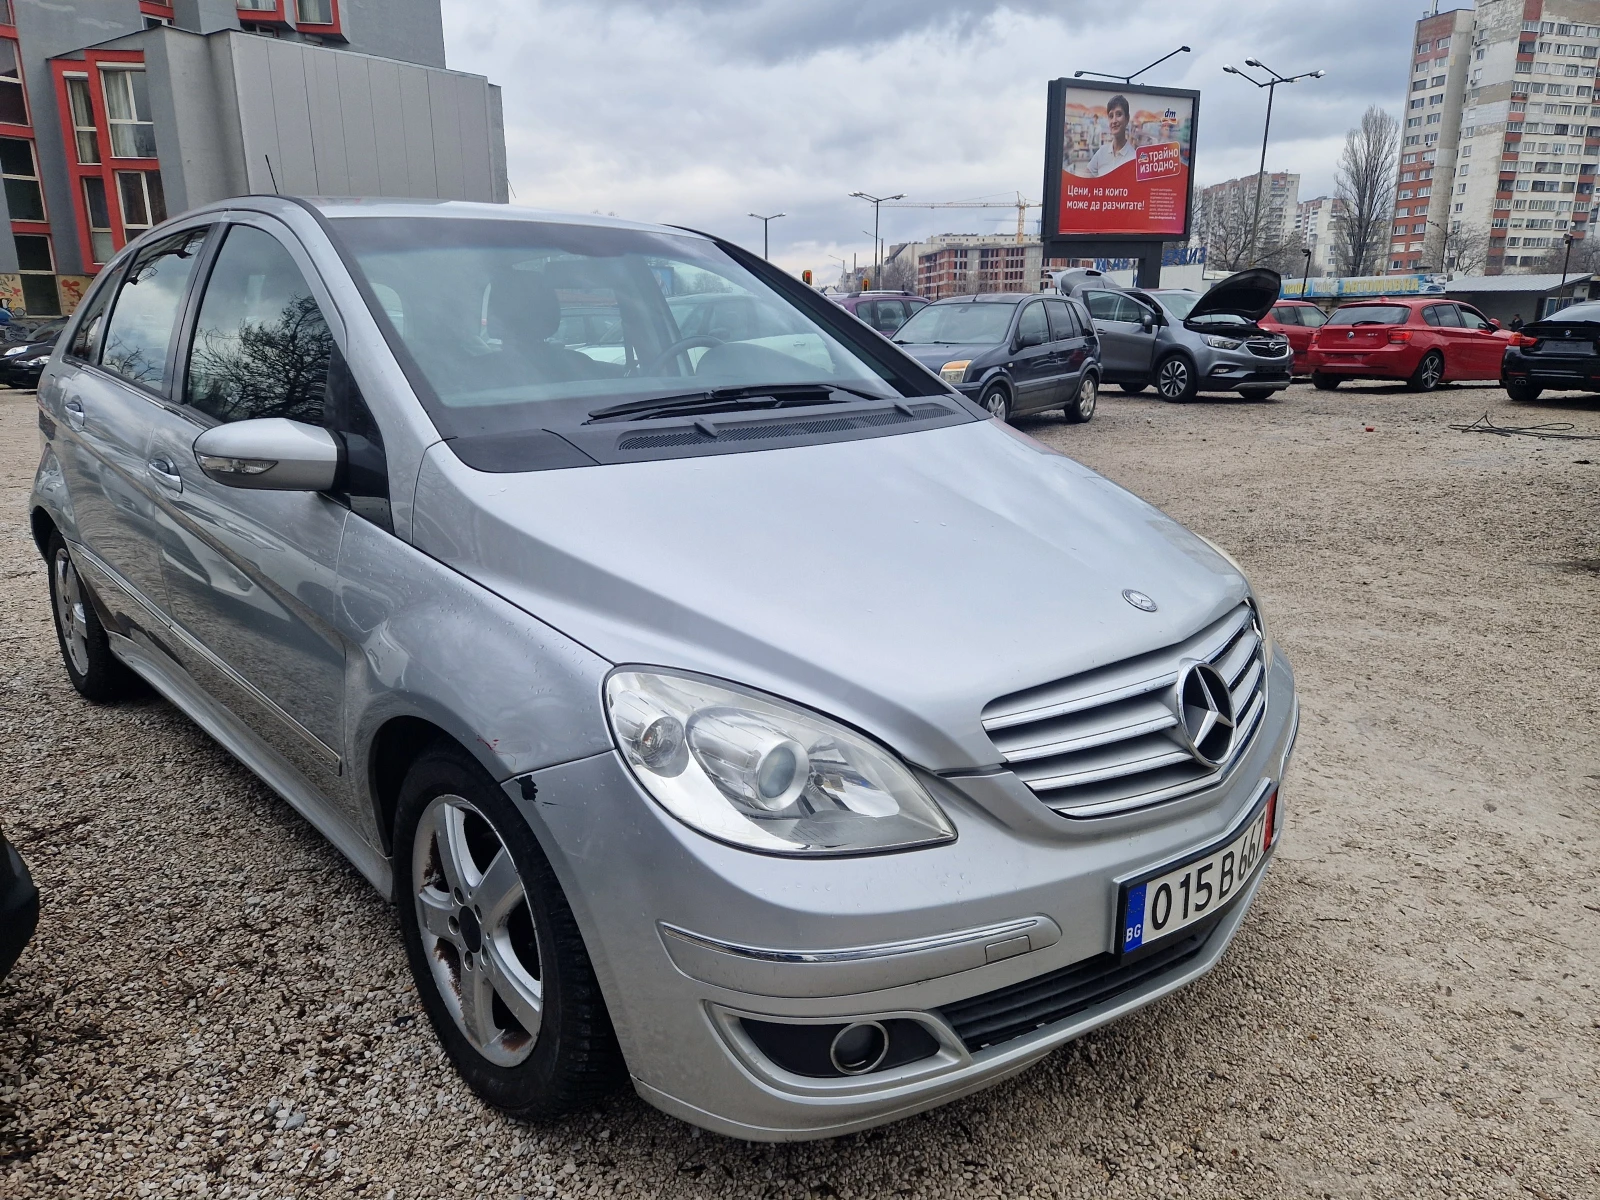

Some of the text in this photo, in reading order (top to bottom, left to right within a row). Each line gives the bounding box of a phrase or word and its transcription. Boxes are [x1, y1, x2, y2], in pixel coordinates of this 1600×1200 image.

[1165, 108, 1176, 118] dm
[1149, 147, 1178, 162] трайно
[1067, 185, 1128, 197] Цени, на които
[1066, 200, 1145, 211] може да разчитате!
[1163, 247, 1206, 265] ЕРВИЗ
[1344, 279, 1419, 293] АВТОМИВКА
[1125, 923, 1141, 943] BG
